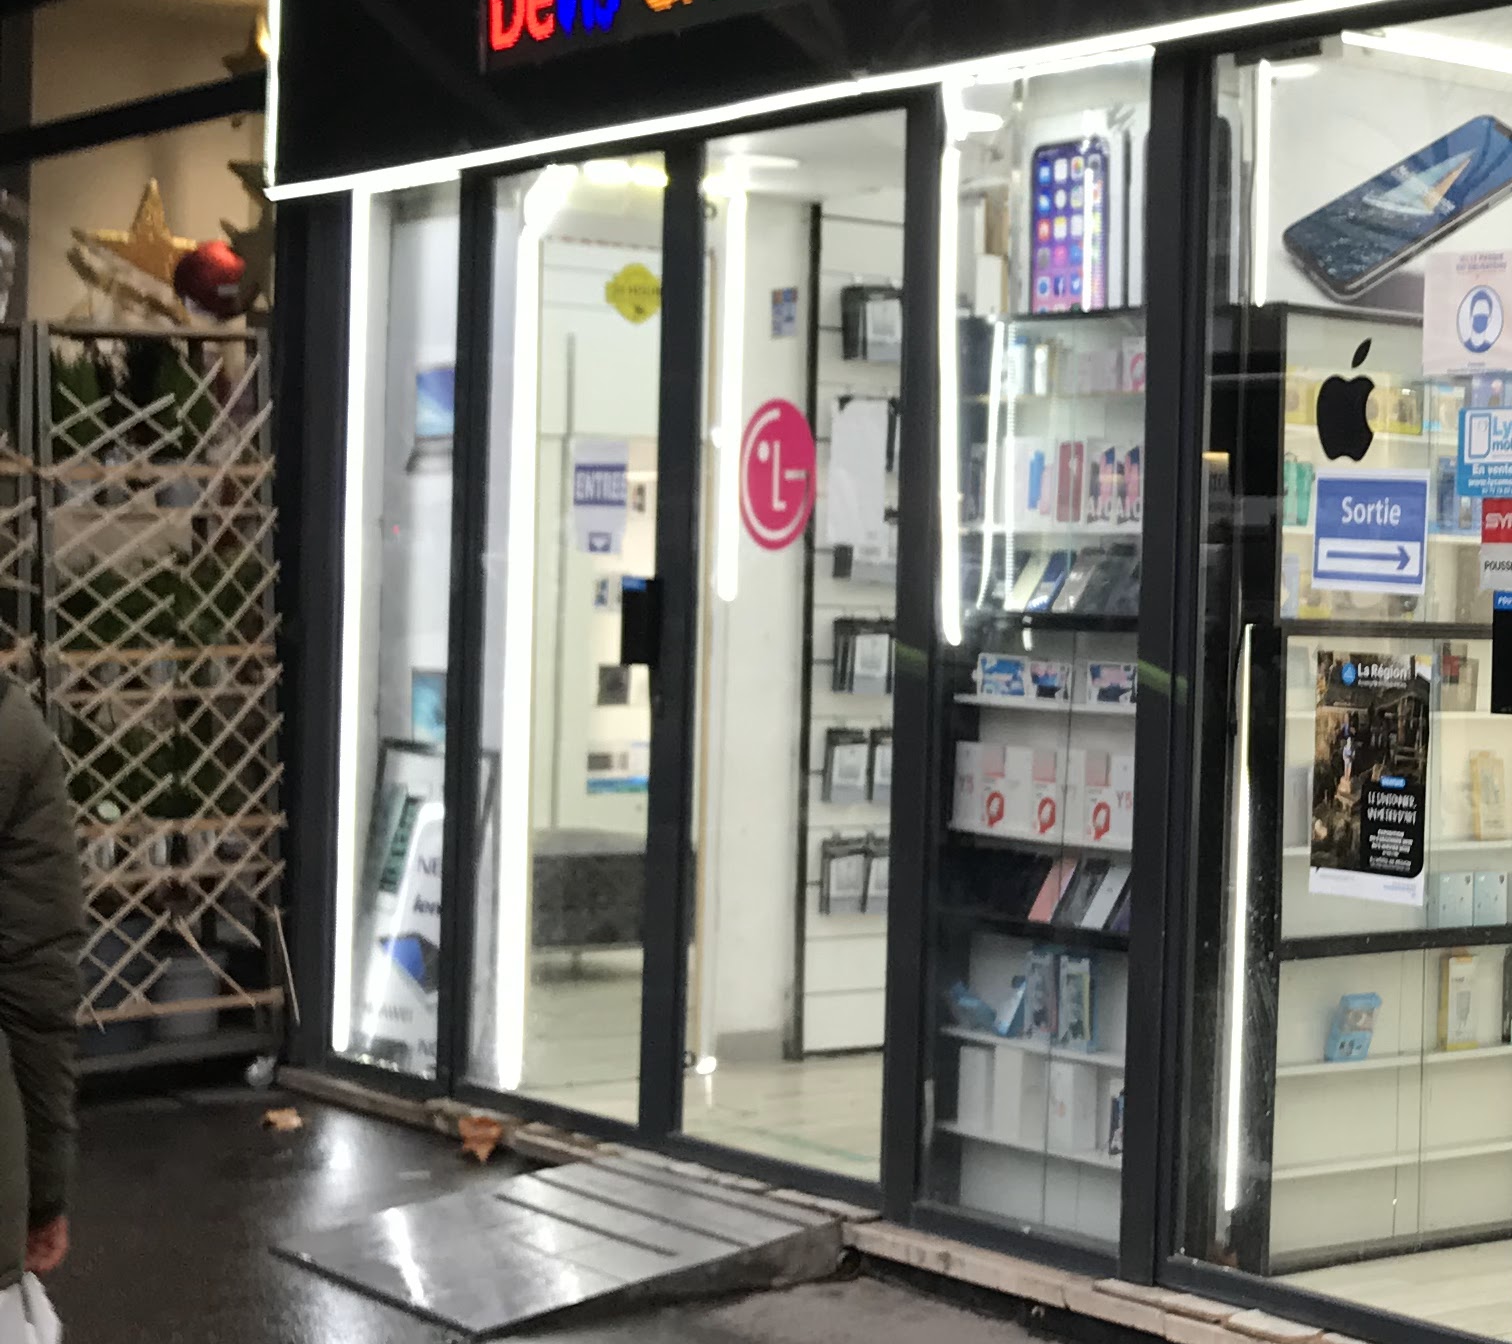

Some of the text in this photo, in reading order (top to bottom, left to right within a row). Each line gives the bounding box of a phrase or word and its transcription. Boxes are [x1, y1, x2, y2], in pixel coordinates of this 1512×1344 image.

[1341, 496, 1402, 525] Sortie
[1357, 662, 1408, 682] La Région
